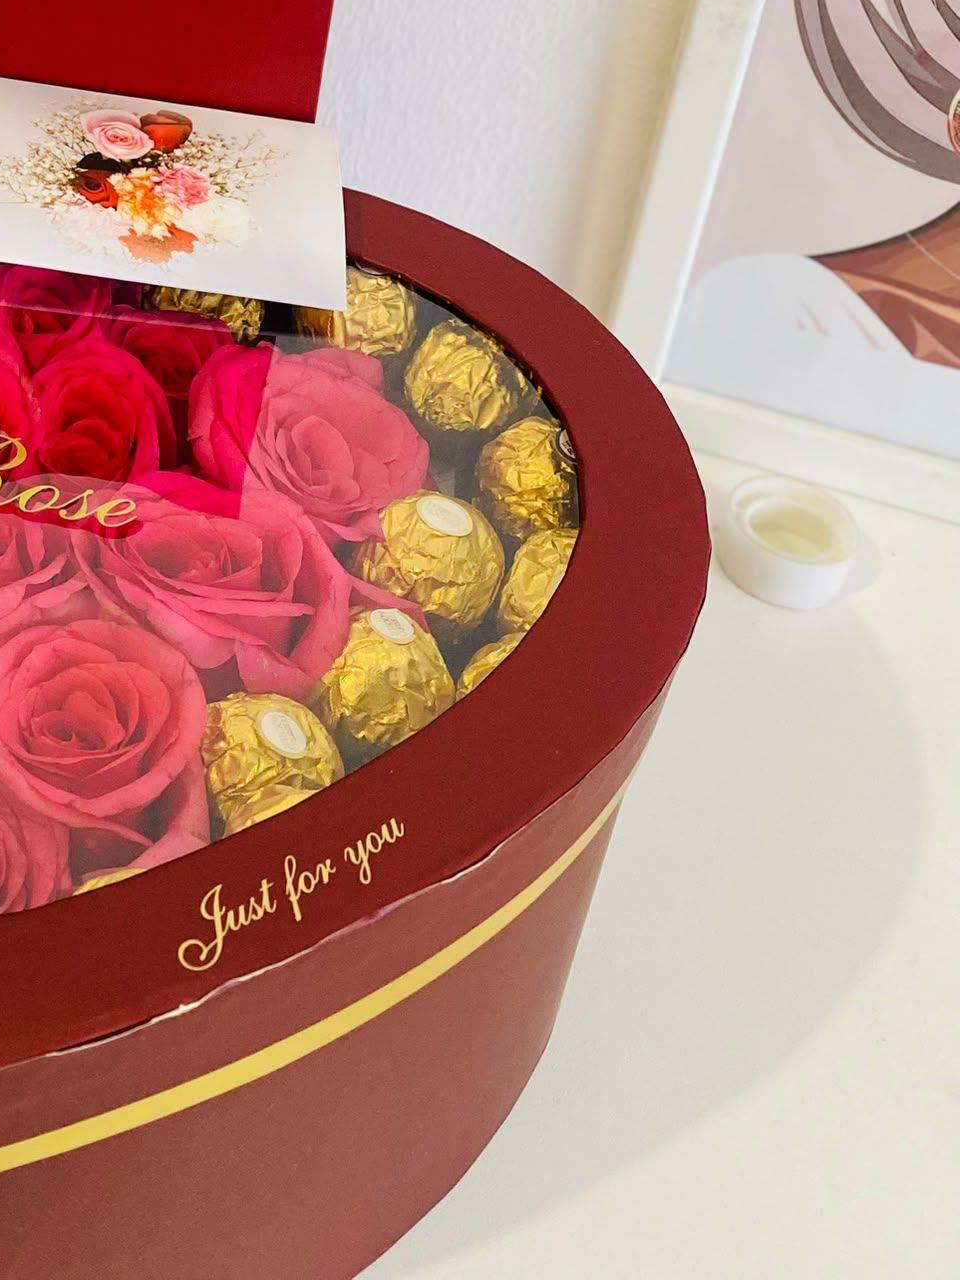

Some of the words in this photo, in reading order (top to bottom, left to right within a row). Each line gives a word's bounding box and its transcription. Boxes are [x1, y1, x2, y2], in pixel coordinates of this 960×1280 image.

[178, 878, 276, 971] Just
[284, 855, 336, 922] for
[344, 818, 405, 885] you
